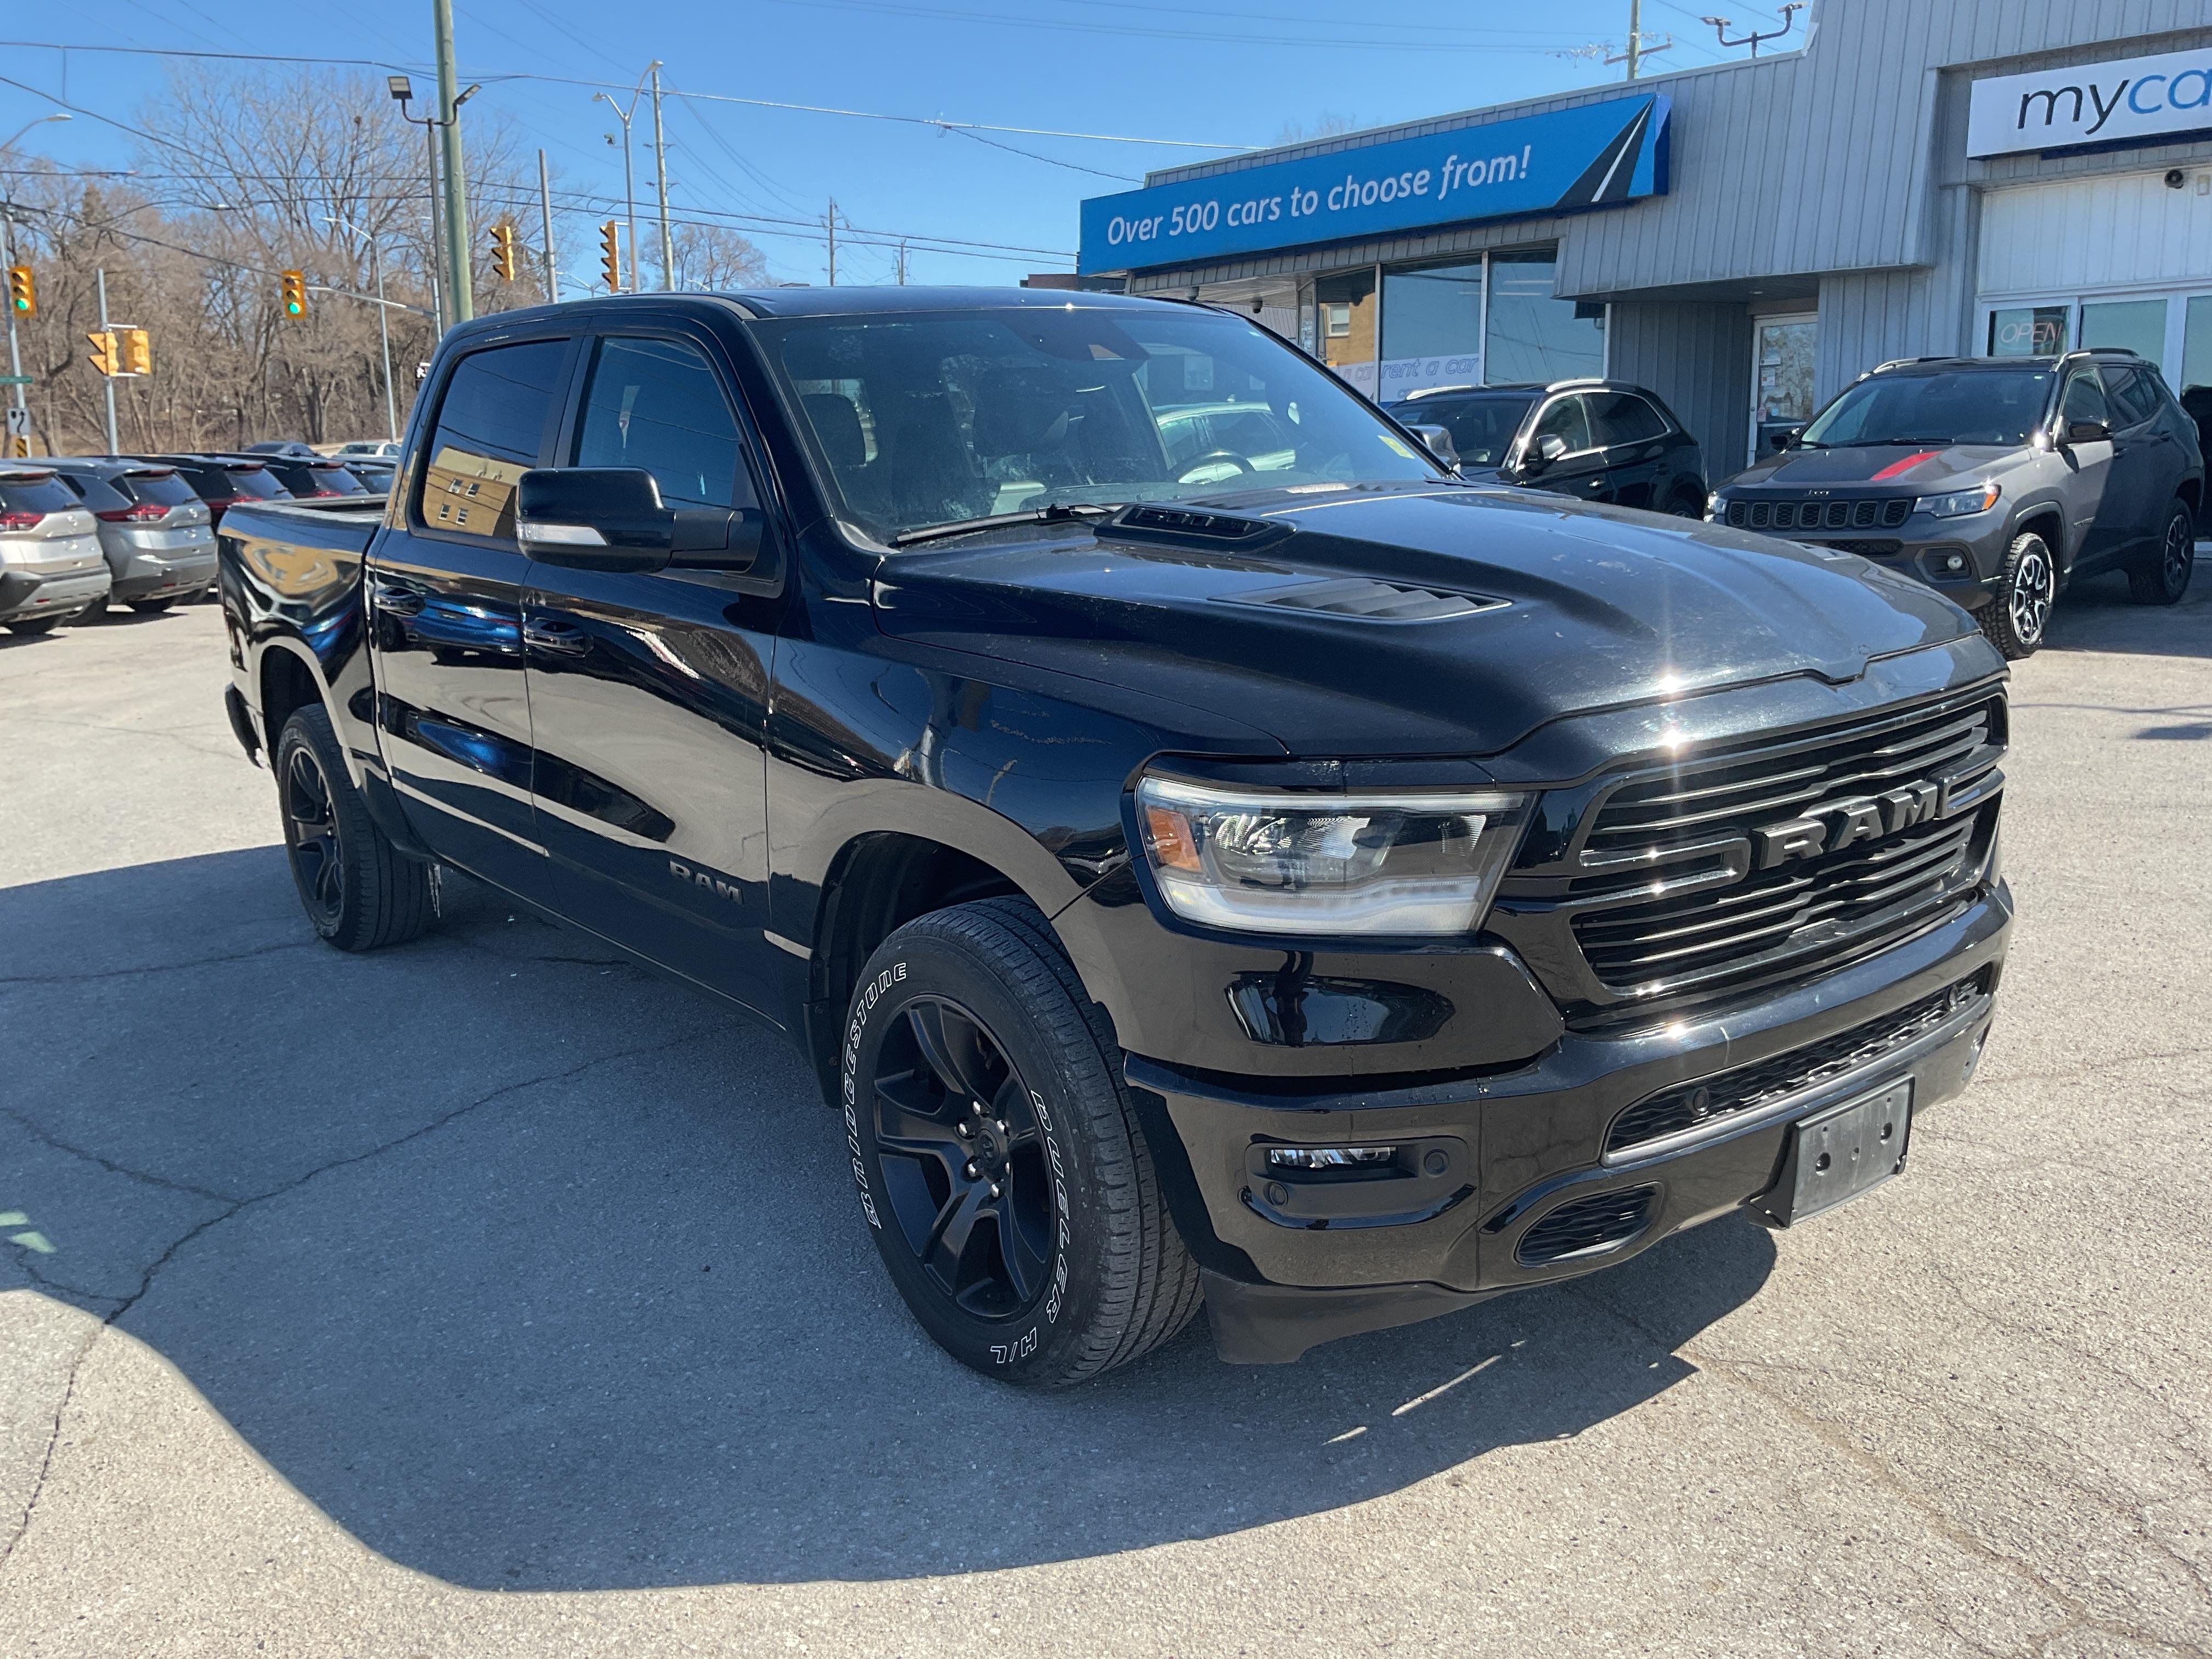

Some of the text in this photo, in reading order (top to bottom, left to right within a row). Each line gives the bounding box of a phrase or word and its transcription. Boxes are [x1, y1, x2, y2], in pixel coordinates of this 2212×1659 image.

[1108, 145, 1531, 245] Over 500 cars to choose from!
[1381, 358, 1479, 379] rent a car
[2001, 322, 2063, 343] OPEN
[1752, 780, 1938, 870] RAM
[669, 860, 742, 905] RAM
[844, 962, 906, 1229] BRIDGESTONE
[990, 1090, 1070, 1364] DUELER H/L
